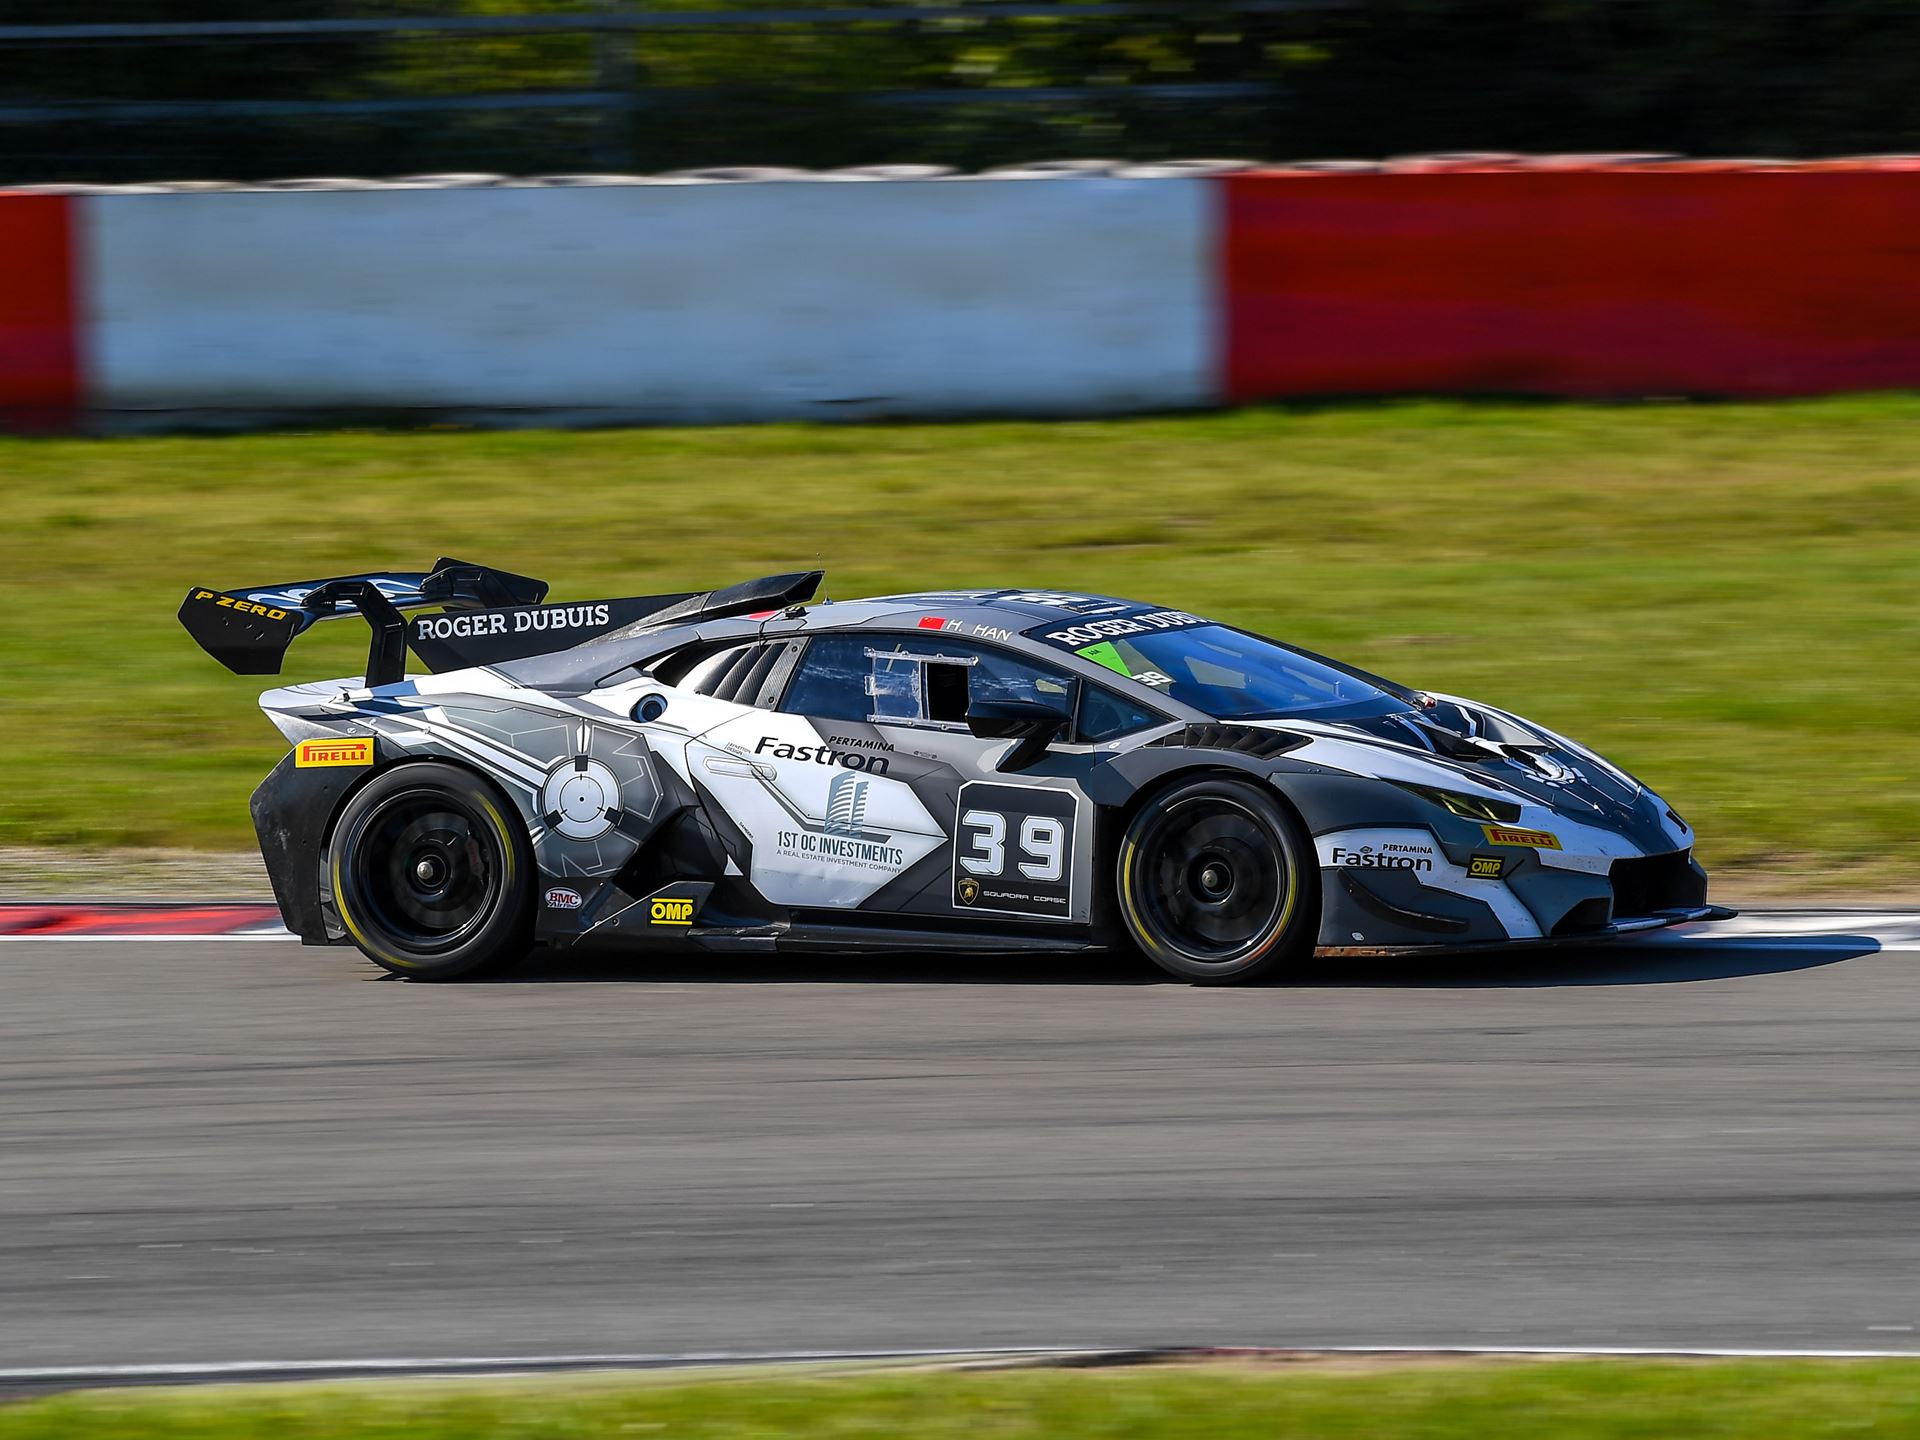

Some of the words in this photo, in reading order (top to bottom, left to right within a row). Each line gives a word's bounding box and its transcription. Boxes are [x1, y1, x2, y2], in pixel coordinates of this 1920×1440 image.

[195, 591, 214, 600] P
[215, 597, 287, 620] ZERO
[418, 614, 508, 640] ROGER
[514, 605, 610, 632] DUBUIS
[946, 619, 963, 632] H.
[972, 624, 1013, 641] HAN
[1045, 619, 1153, 646] ROGER
[1130, 671, 1172, 686] 39
[828, 735, 895, 752] PERTAMINA
[303, 744, 366, 762] PIRELLI
[754, 736, 890, 774] Fastron
[960, 809, 1065, 882] 39
[1489, 828, 1554, 847] PIRELLI
[777, 831, 799, 849] 1ST
[800, 834, 817, 852] OC
[819, 837, 903, 865] INVESTMENTS
[1382, 843, 1433, 855] PERTAMINA
[801, 853, 826, 863] ESTATE
[826, 856, 868, 869] INVESTMENT
[1332, 847, 1432, 871] Fastron
[1471, 861, 1501, 875] OMP
[550, 892, 578, 905] BMC
[983, 890, 1029, 900] SQUADRA
[1033, 895, 1067, 904] CORSE
[651, 903, 693, 920] OMP
